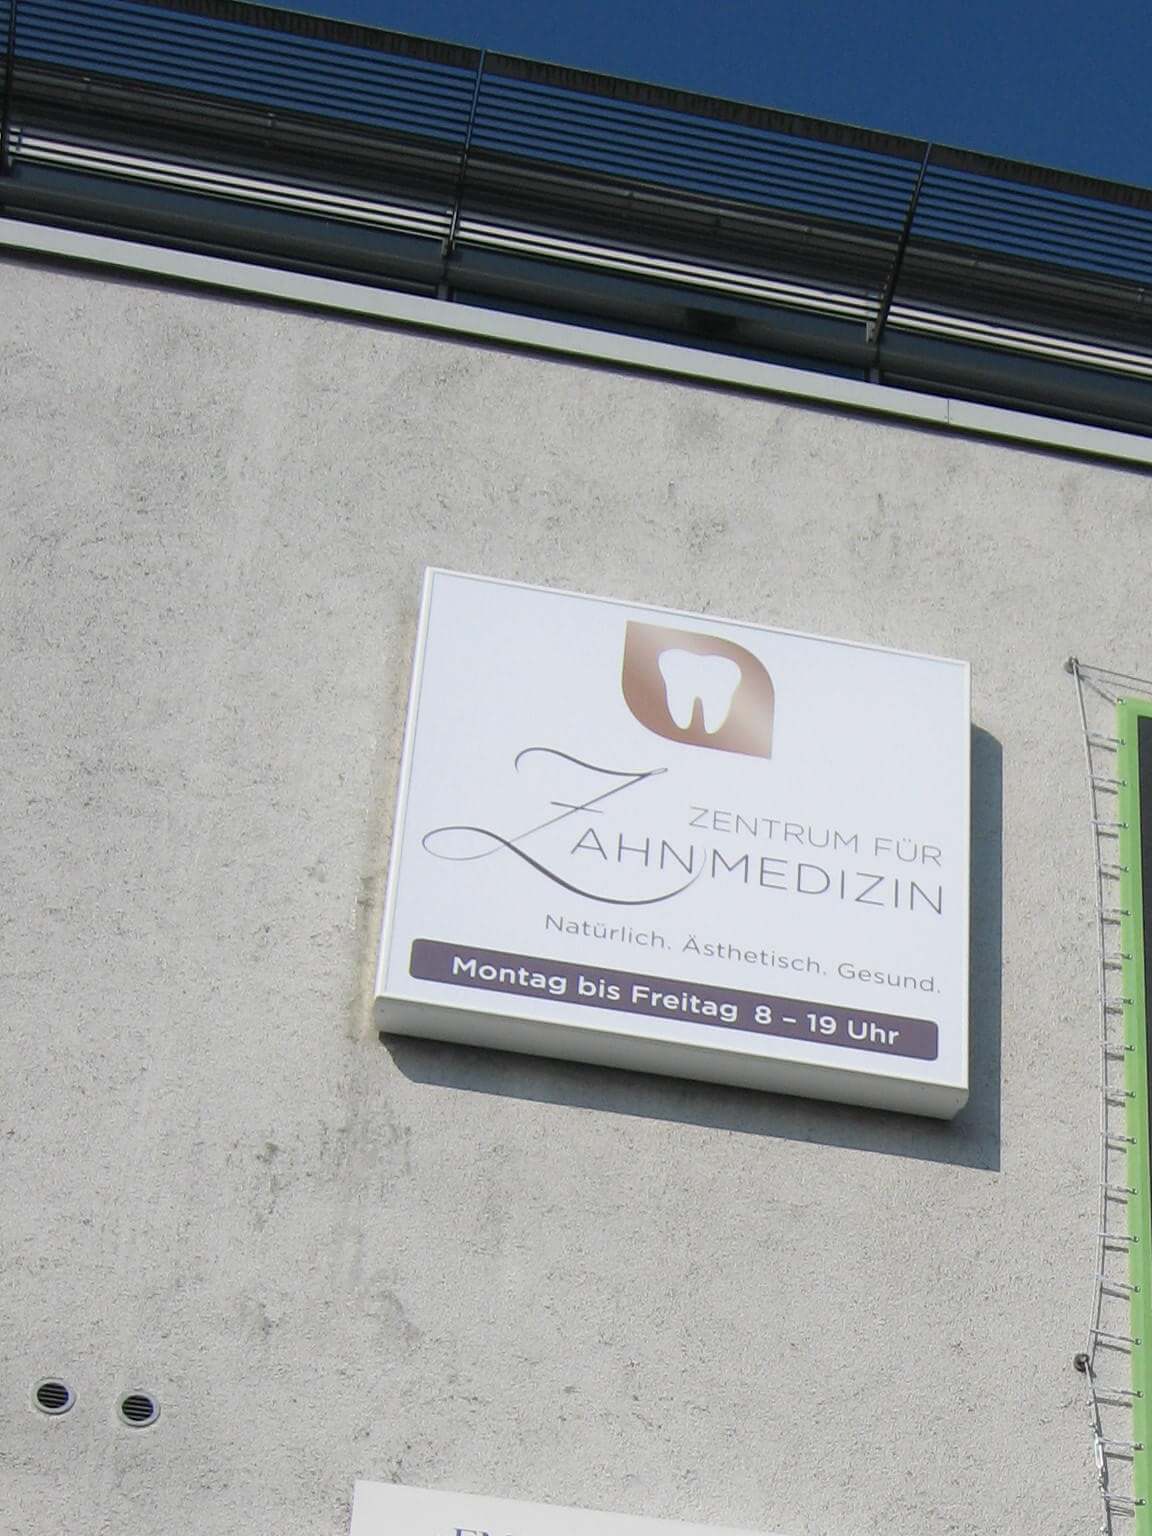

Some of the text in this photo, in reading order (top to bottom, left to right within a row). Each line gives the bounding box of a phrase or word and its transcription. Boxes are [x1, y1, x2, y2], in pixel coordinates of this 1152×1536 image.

[421, 746, 944, 915] ZAHNMEDIZIN
[688, 805, 943, 868] ZENTRUM FÜR
[544, 913, 942, 994] Natürlich. Ästhetisch. Gesund.
[452, 955, 568, 995] Montag
[577, 975, 621, 1001] bis
[631, 984, 739, 1023] Freitag
[753, 1004, 773, 1026] 8
[806, 1012, 838, 1036] 19
[847, 1018, 900, 1046] Uhr
